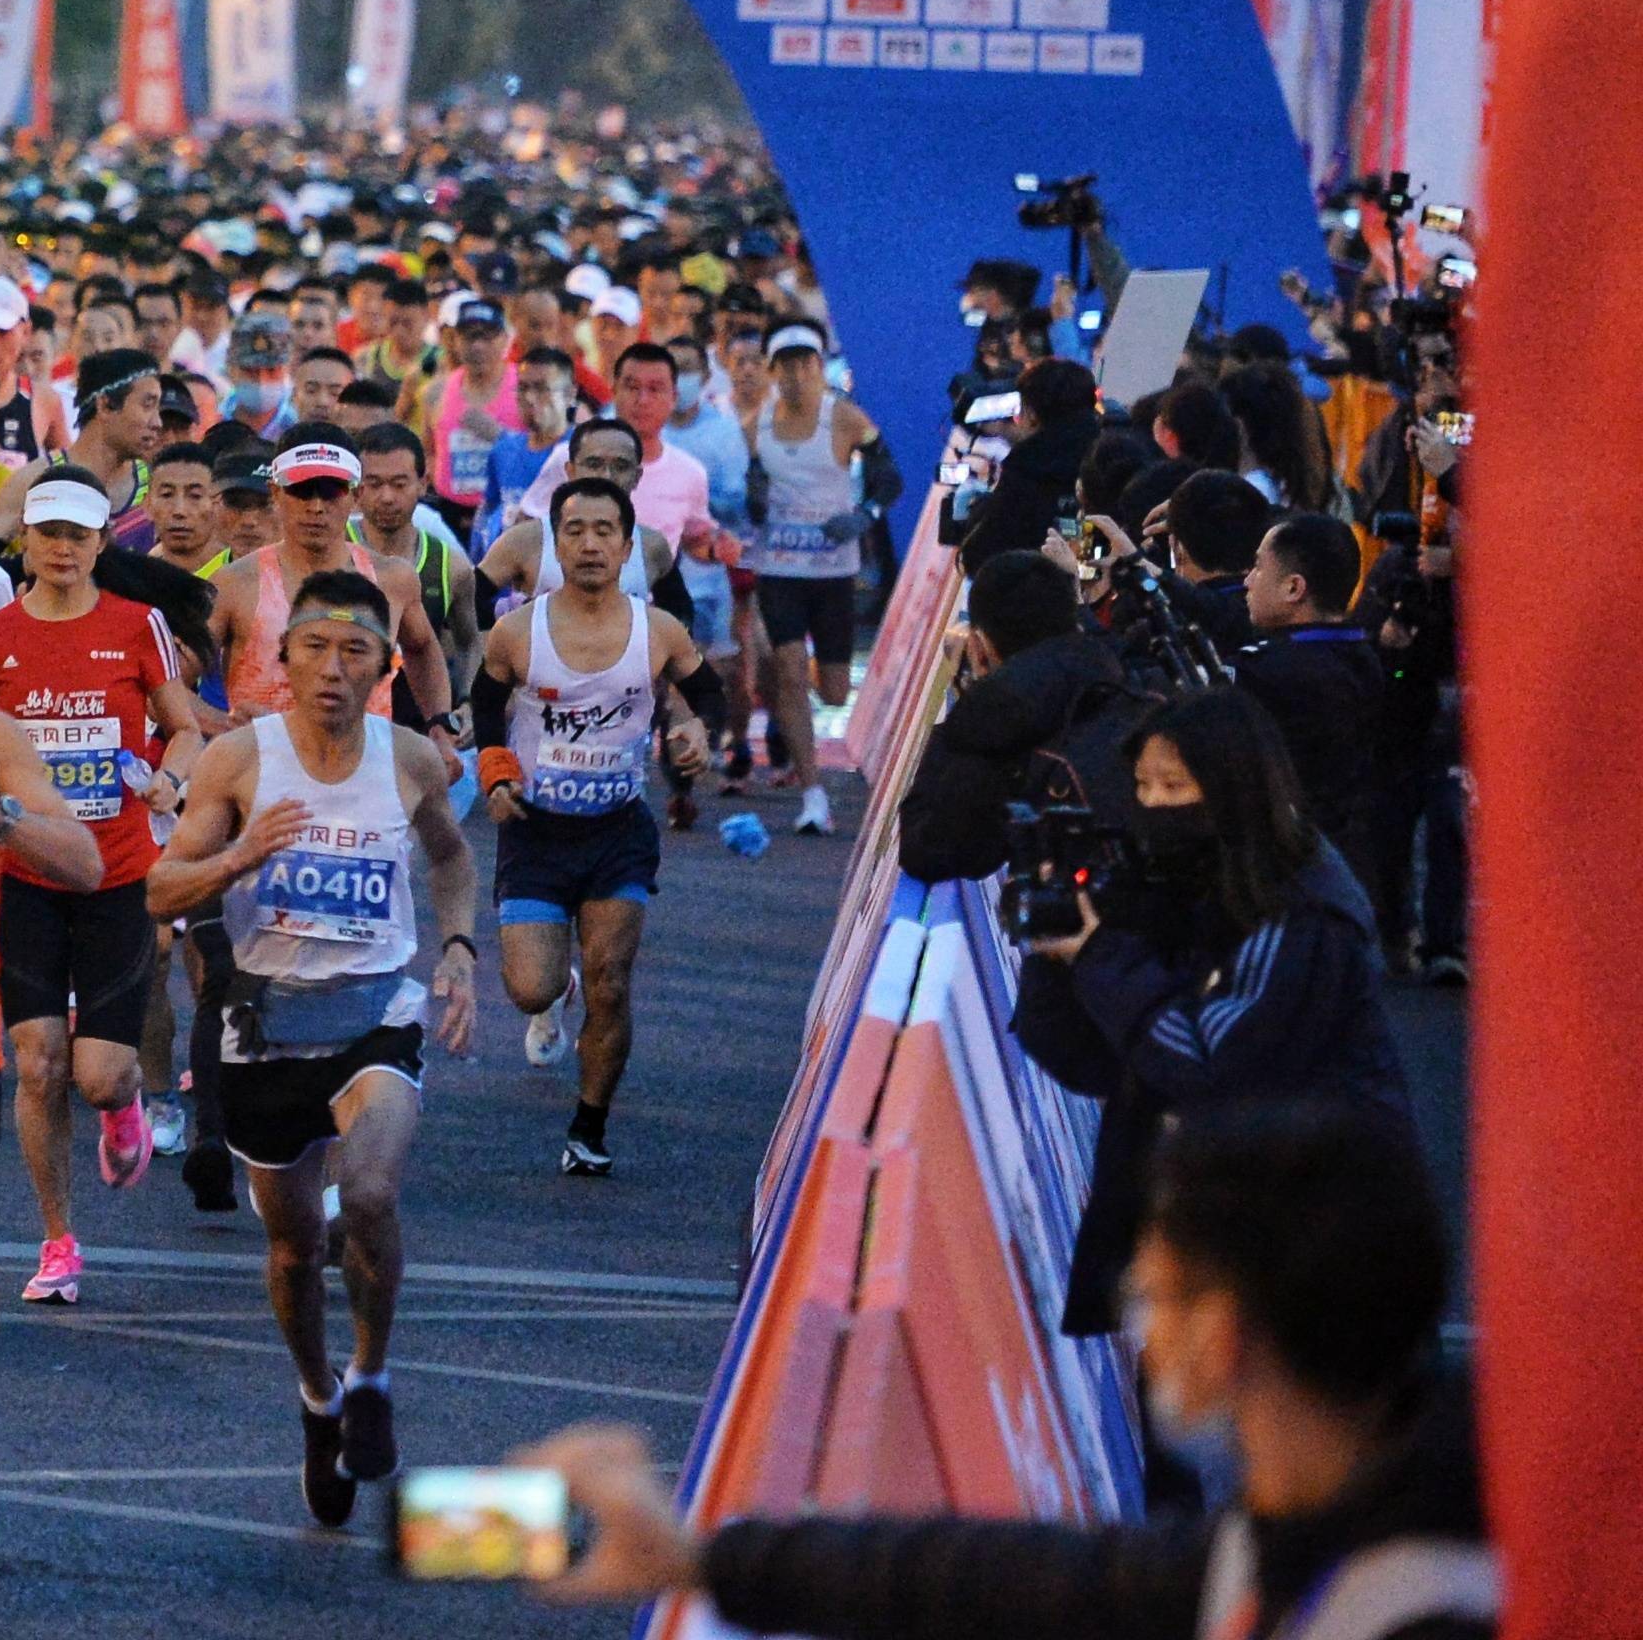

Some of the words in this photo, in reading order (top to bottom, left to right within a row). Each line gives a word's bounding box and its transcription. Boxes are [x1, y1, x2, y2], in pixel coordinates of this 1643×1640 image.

[26, 726, 105, 744] 东风日产
[536, 776, 630, 806] A0439
[266, 863, 388, 905] A0410
